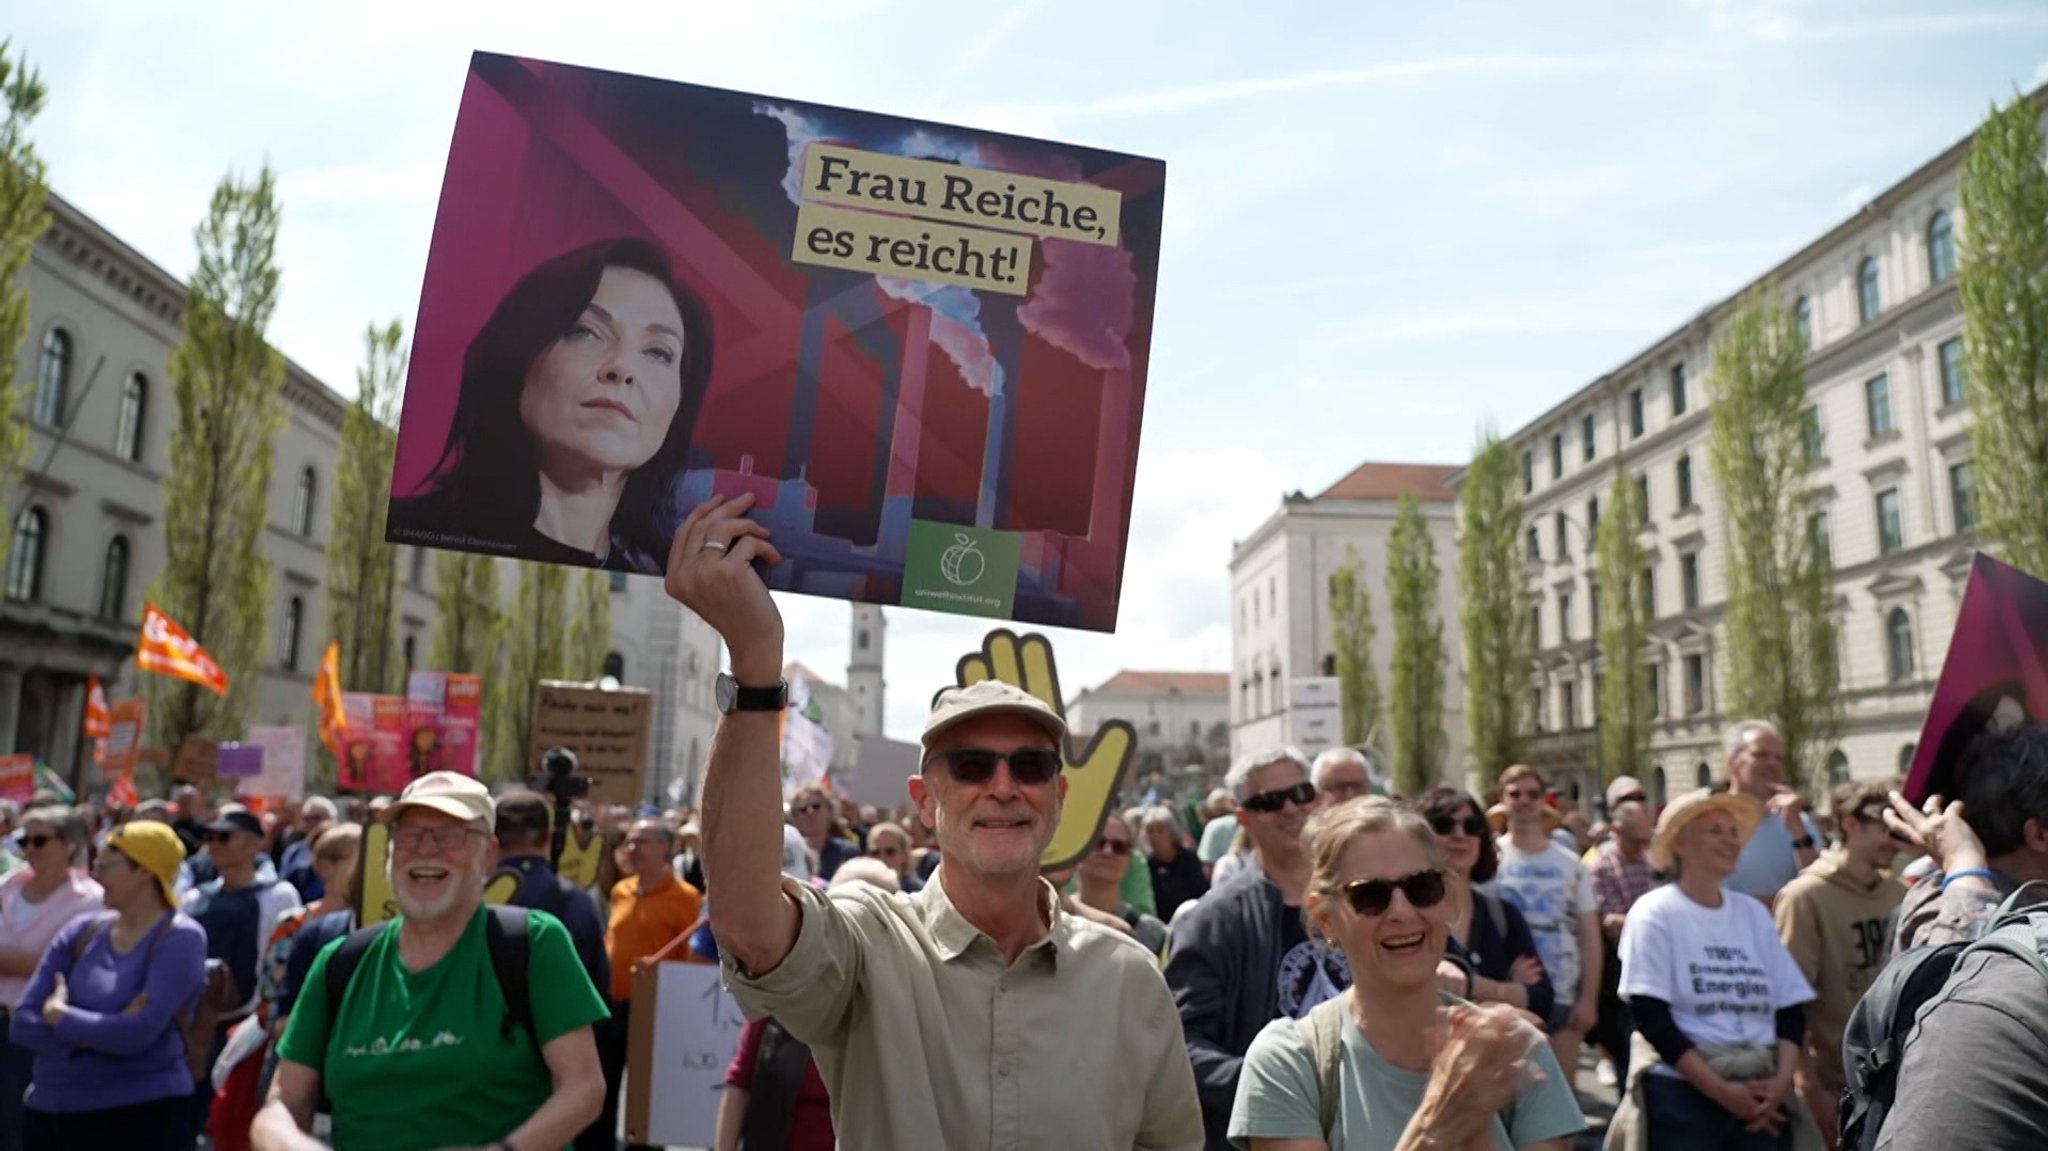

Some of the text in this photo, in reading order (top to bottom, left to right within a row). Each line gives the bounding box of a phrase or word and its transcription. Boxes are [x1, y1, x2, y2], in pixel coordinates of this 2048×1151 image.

[815, 156, 1107, 240] Frau Reiche,
[807, 226, 1019, 284] es reicht!
[914, 589, 1001, 608] umweltinstitut.org
[1692, 977, 1769, 1000] Energien
